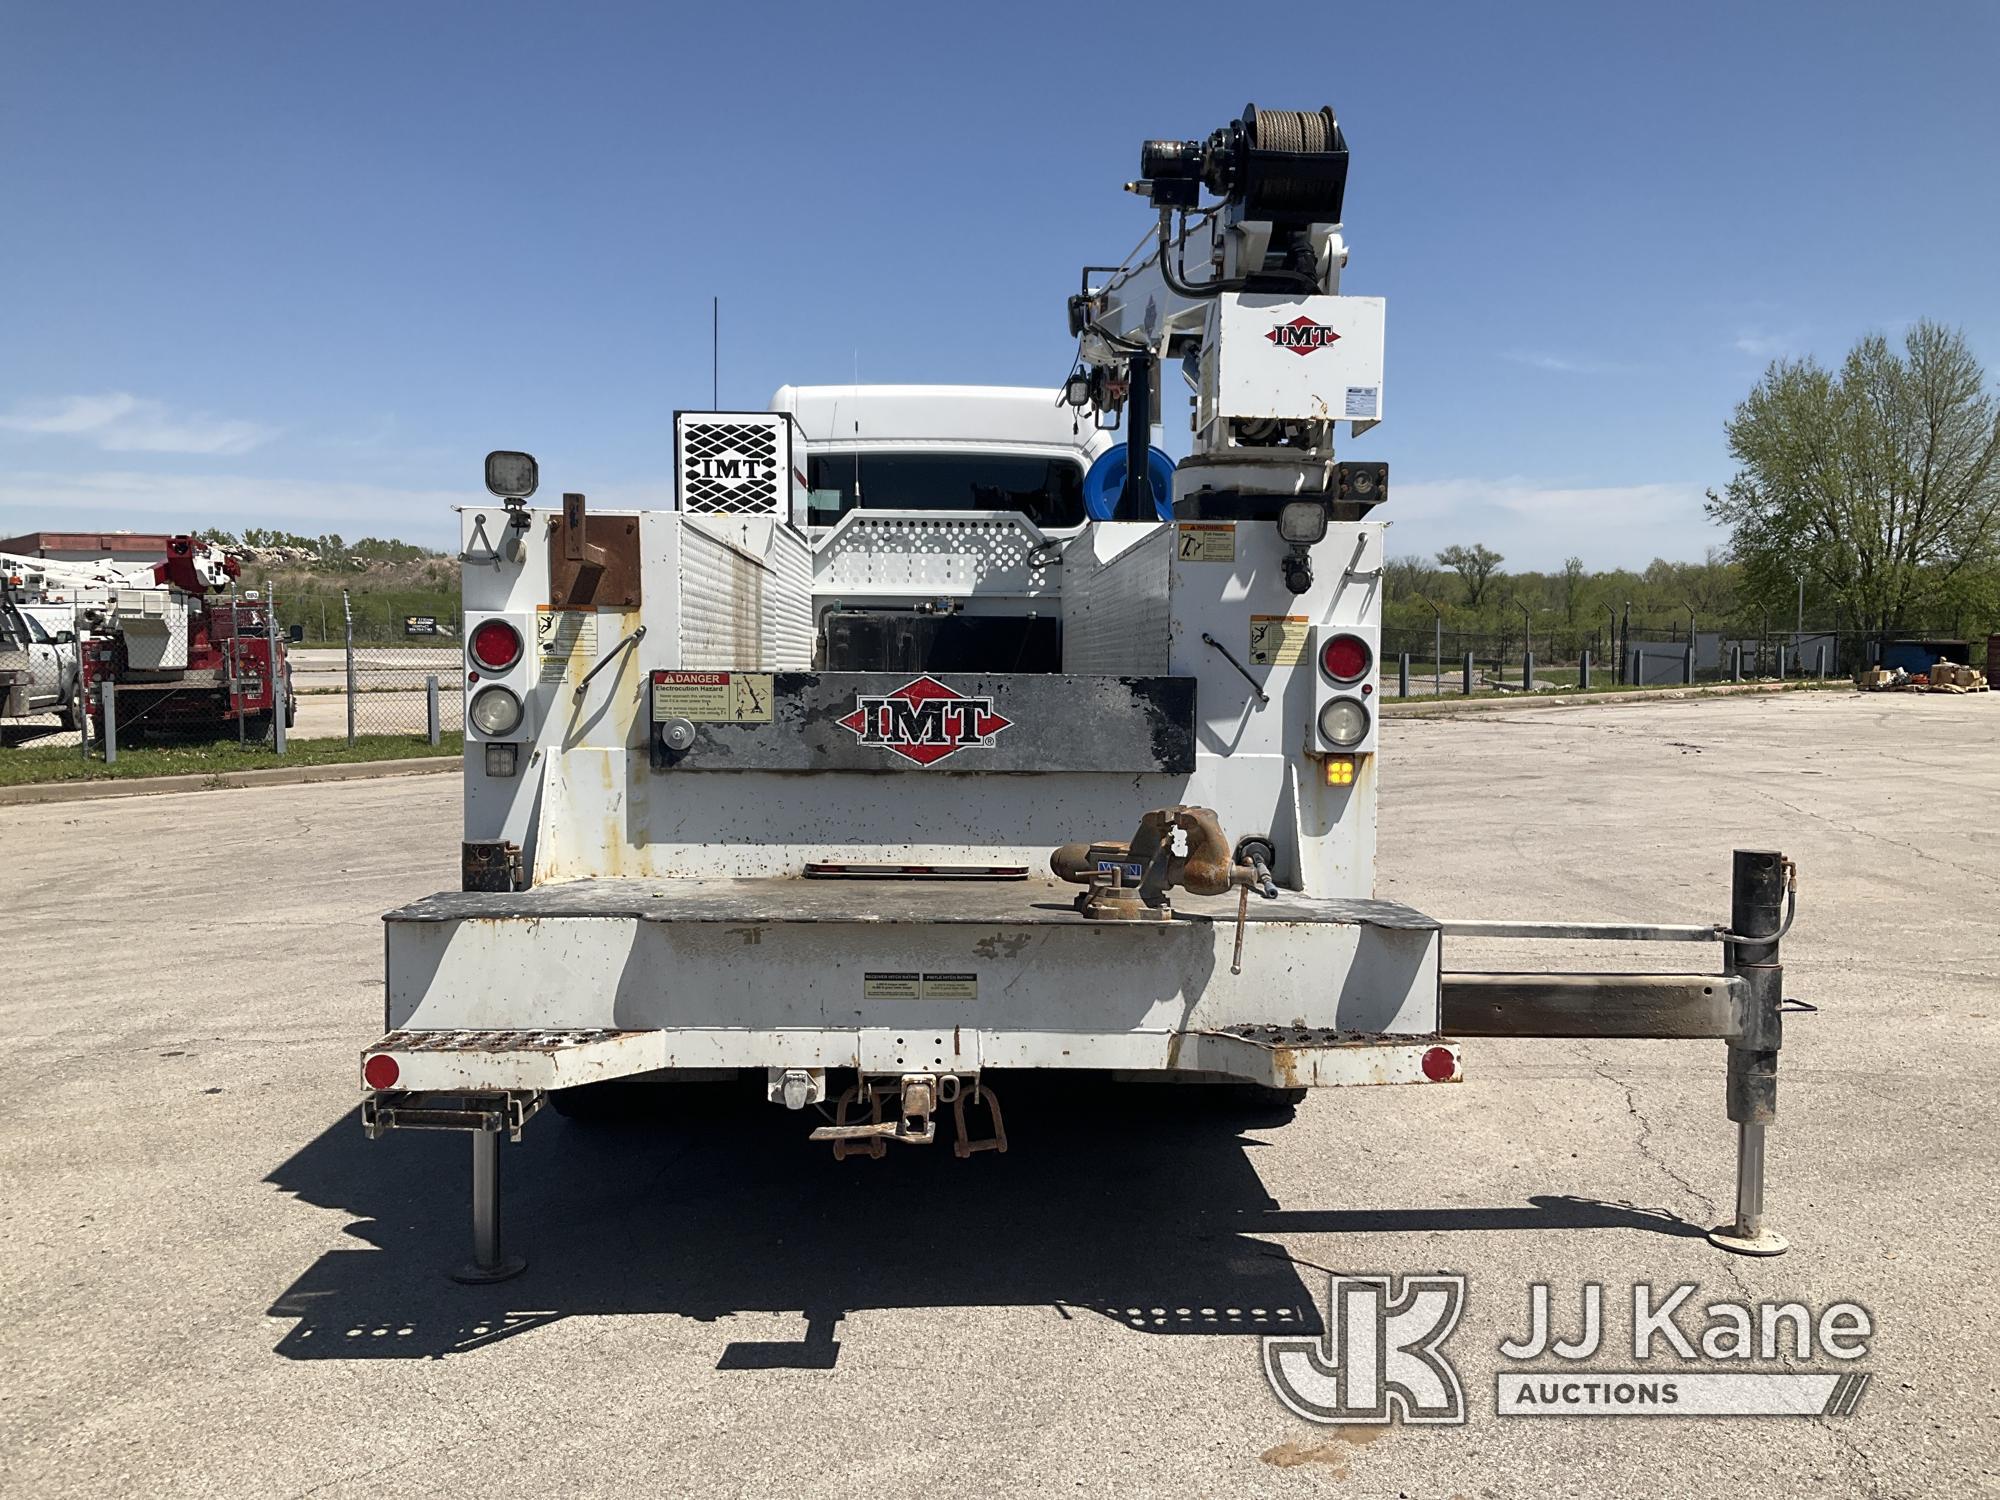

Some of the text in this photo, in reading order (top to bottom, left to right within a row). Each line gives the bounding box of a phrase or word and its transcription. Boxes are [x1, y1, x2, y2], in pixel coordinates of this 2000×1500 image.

[1274, 325, 1332, 346] IMT
[702, 459, 760, 478] IMT
[675, 674, 720, 684] DANGER
[860, 698, 992, 745] IMT
